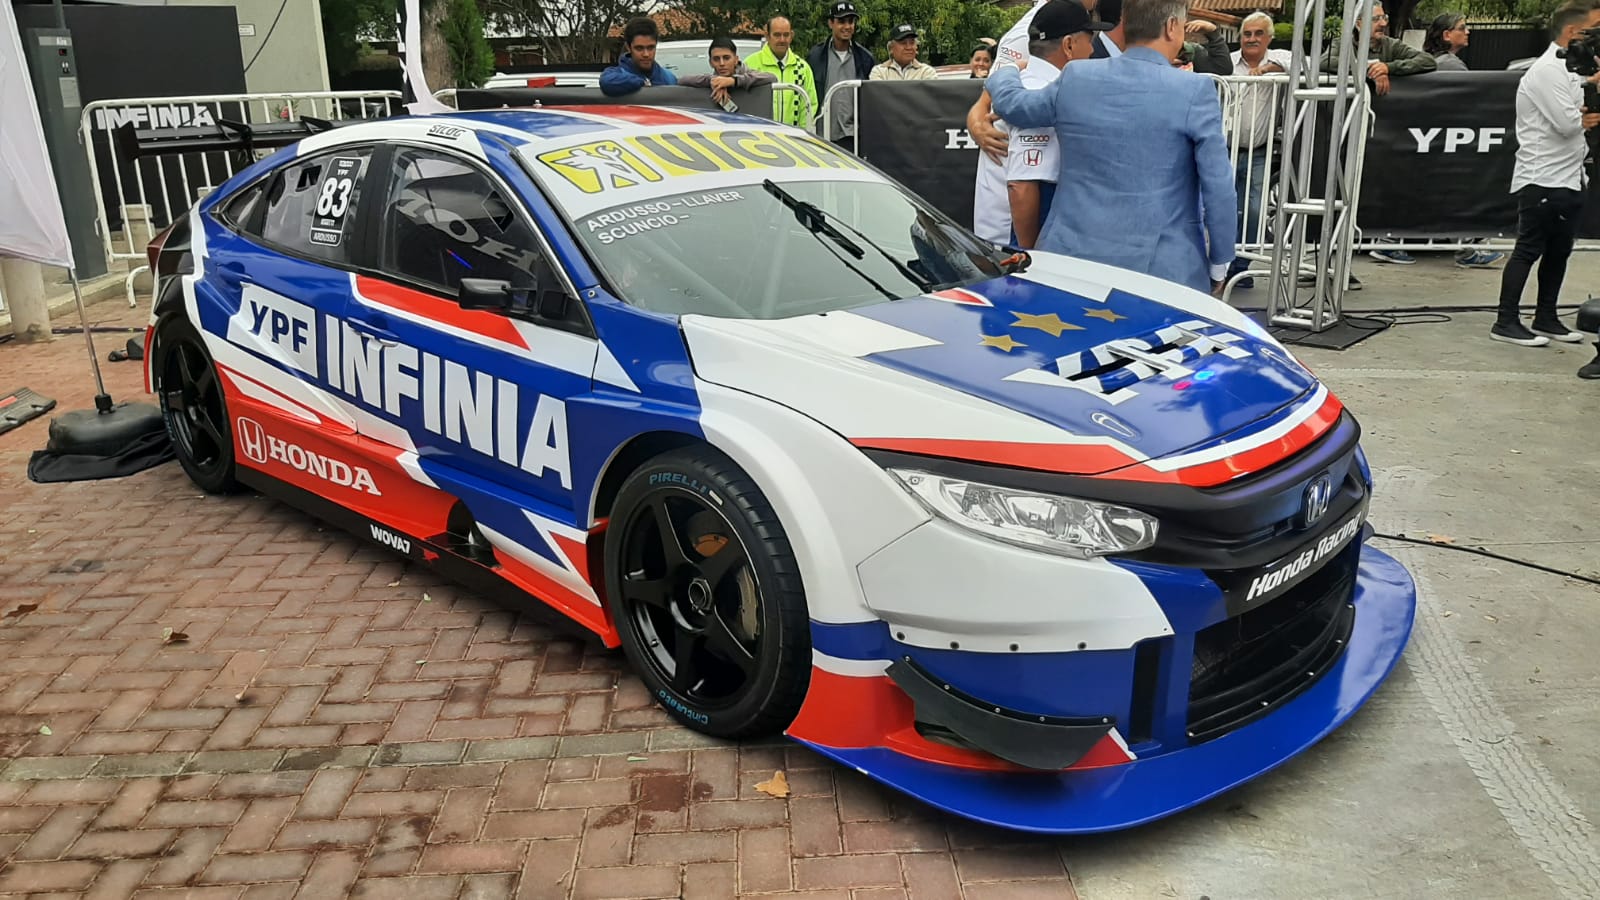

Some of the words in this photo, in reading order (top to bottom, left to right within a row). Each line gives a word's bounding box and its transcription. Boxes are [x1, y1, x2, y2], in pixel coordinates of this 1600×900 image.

[95, 104, 217, 130] INFINIA
[1407, 127, 1506, 153] YPF
[317, 177, 352, 218] 83
[249, 300, 309, 353] YPF
[325, 314, 573, 490] INFINIA
[267, 435, 382, 496] HONDA
[648, 472, 709, 496] PIRELLI
[1246, 549, 1315, 601] Honda
[1313, 511, 1362, 562] Racing
